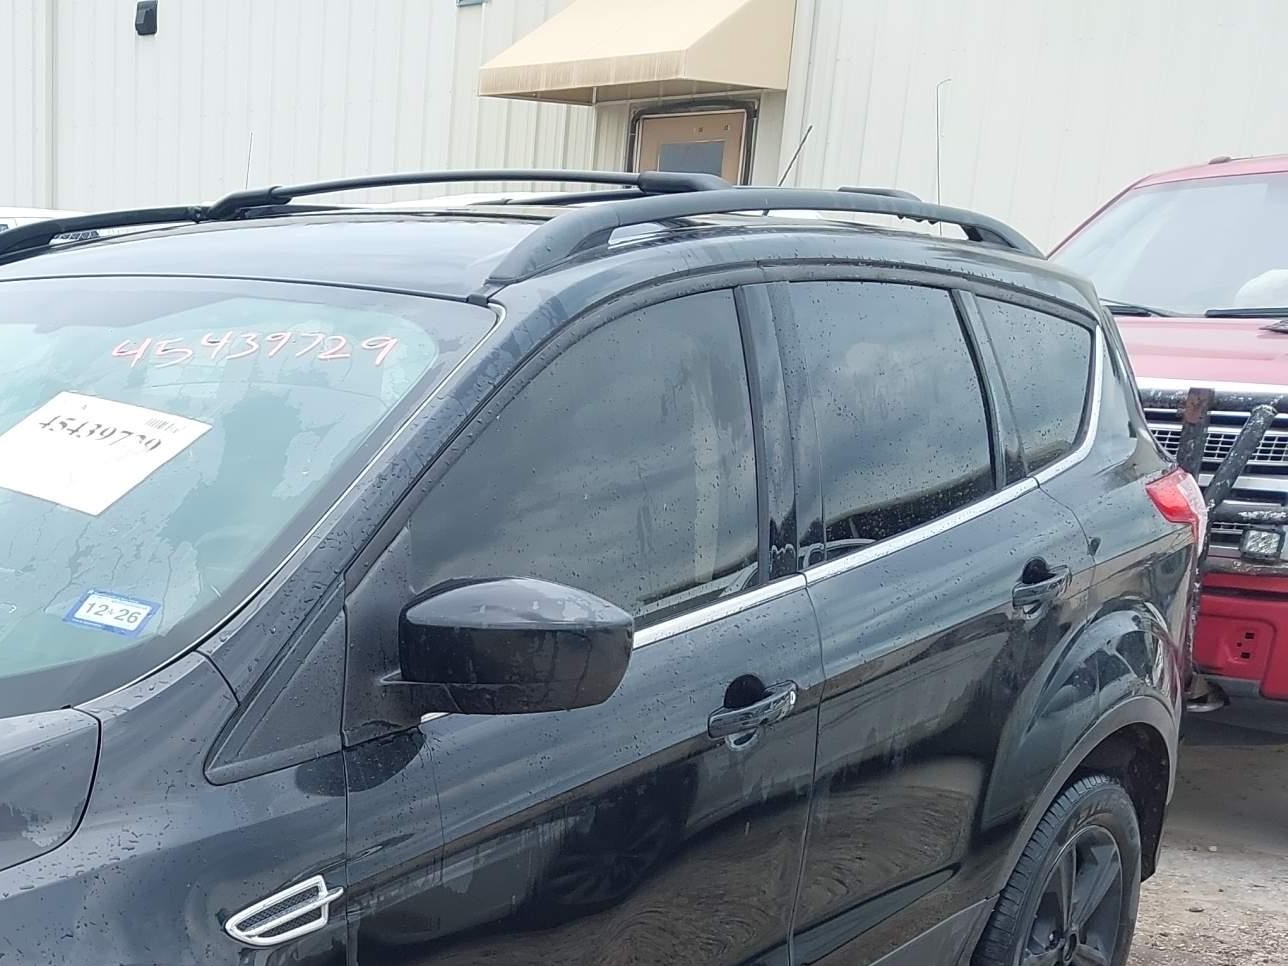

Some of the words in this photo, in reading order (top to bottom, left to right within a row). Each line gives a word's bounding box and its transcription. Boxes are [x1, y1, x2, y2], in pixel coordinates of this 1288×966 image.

[111, 331, 398, 368] 45439729
[85, 602, 109, 616] 12
[114, 608, 142, 624] 26
